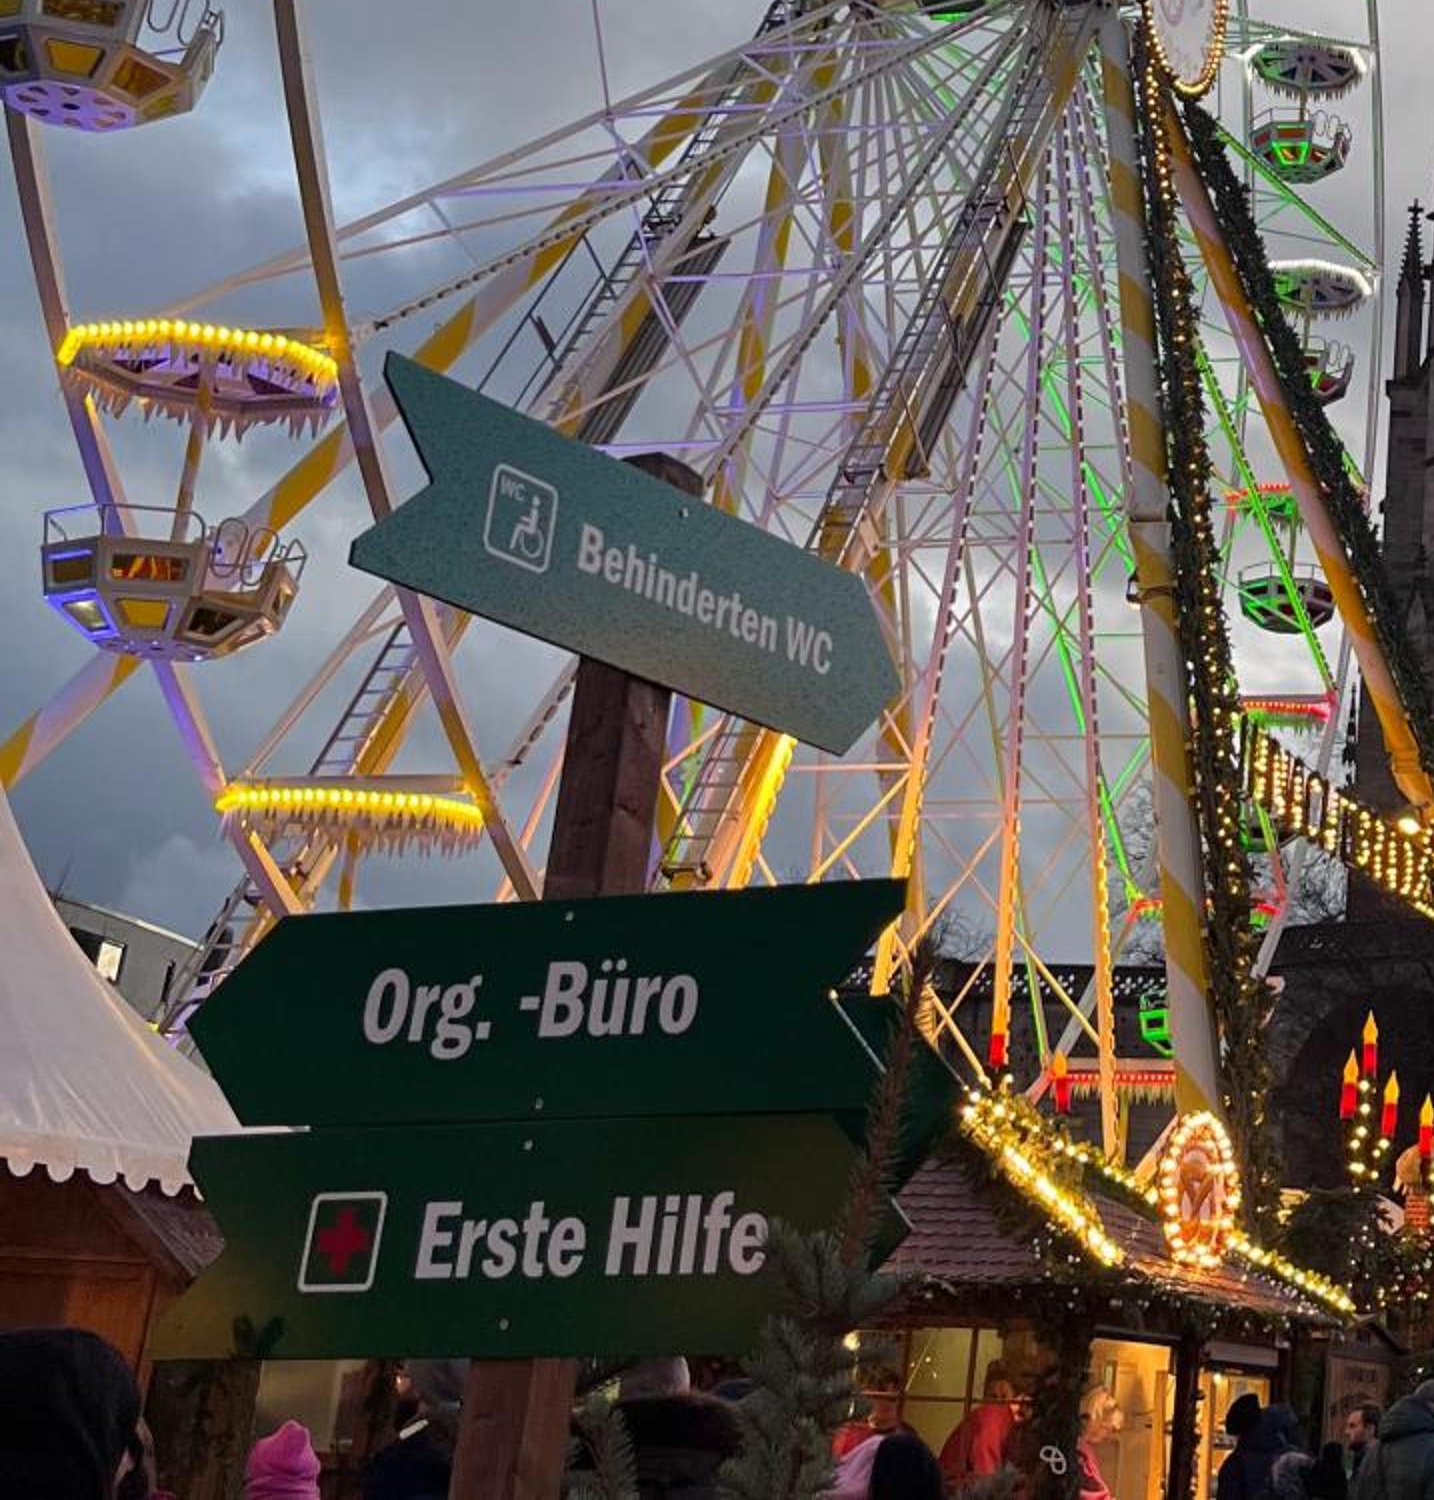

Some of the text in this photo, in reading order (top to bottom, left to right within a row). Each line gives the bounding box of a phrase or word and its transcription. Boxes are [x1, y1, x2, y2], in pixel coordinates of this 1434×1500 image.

[578, 522, 832, 675] Behinderten WC
[363, 958, 698, 1060] Org. -Büro
[415, 1191, 769, 1279] Erste Hilfe
